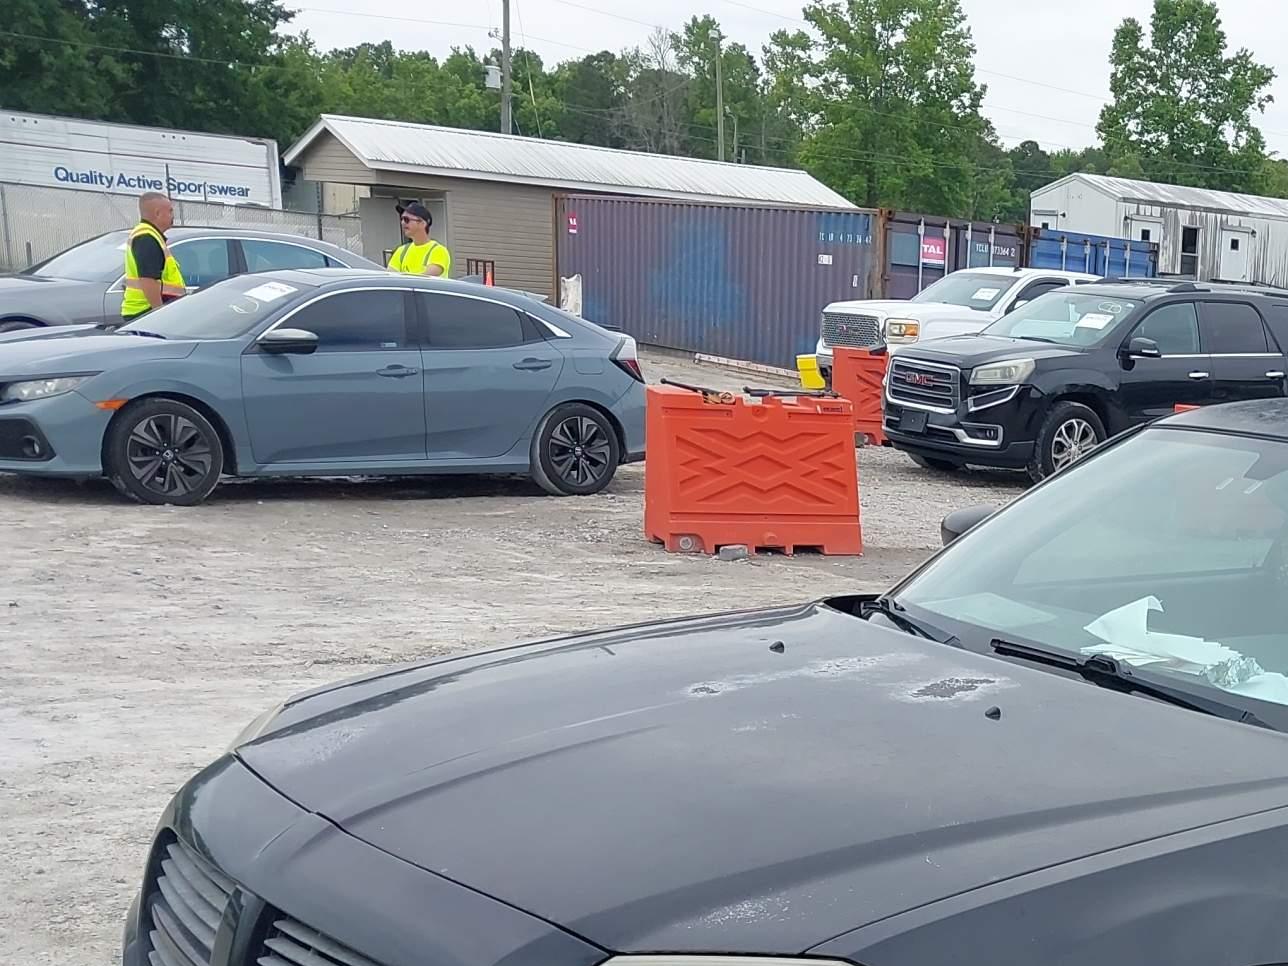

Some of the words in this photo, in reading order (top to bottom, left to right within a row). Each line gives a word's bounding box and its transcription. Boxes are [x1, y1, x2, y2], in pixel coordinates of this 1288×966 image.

[54, 166, 114, 189] Quality
[117, 173, 163, 191] Active
[922, 244, 944, 255] TAL
[905, 371, 934, 387] GMC
